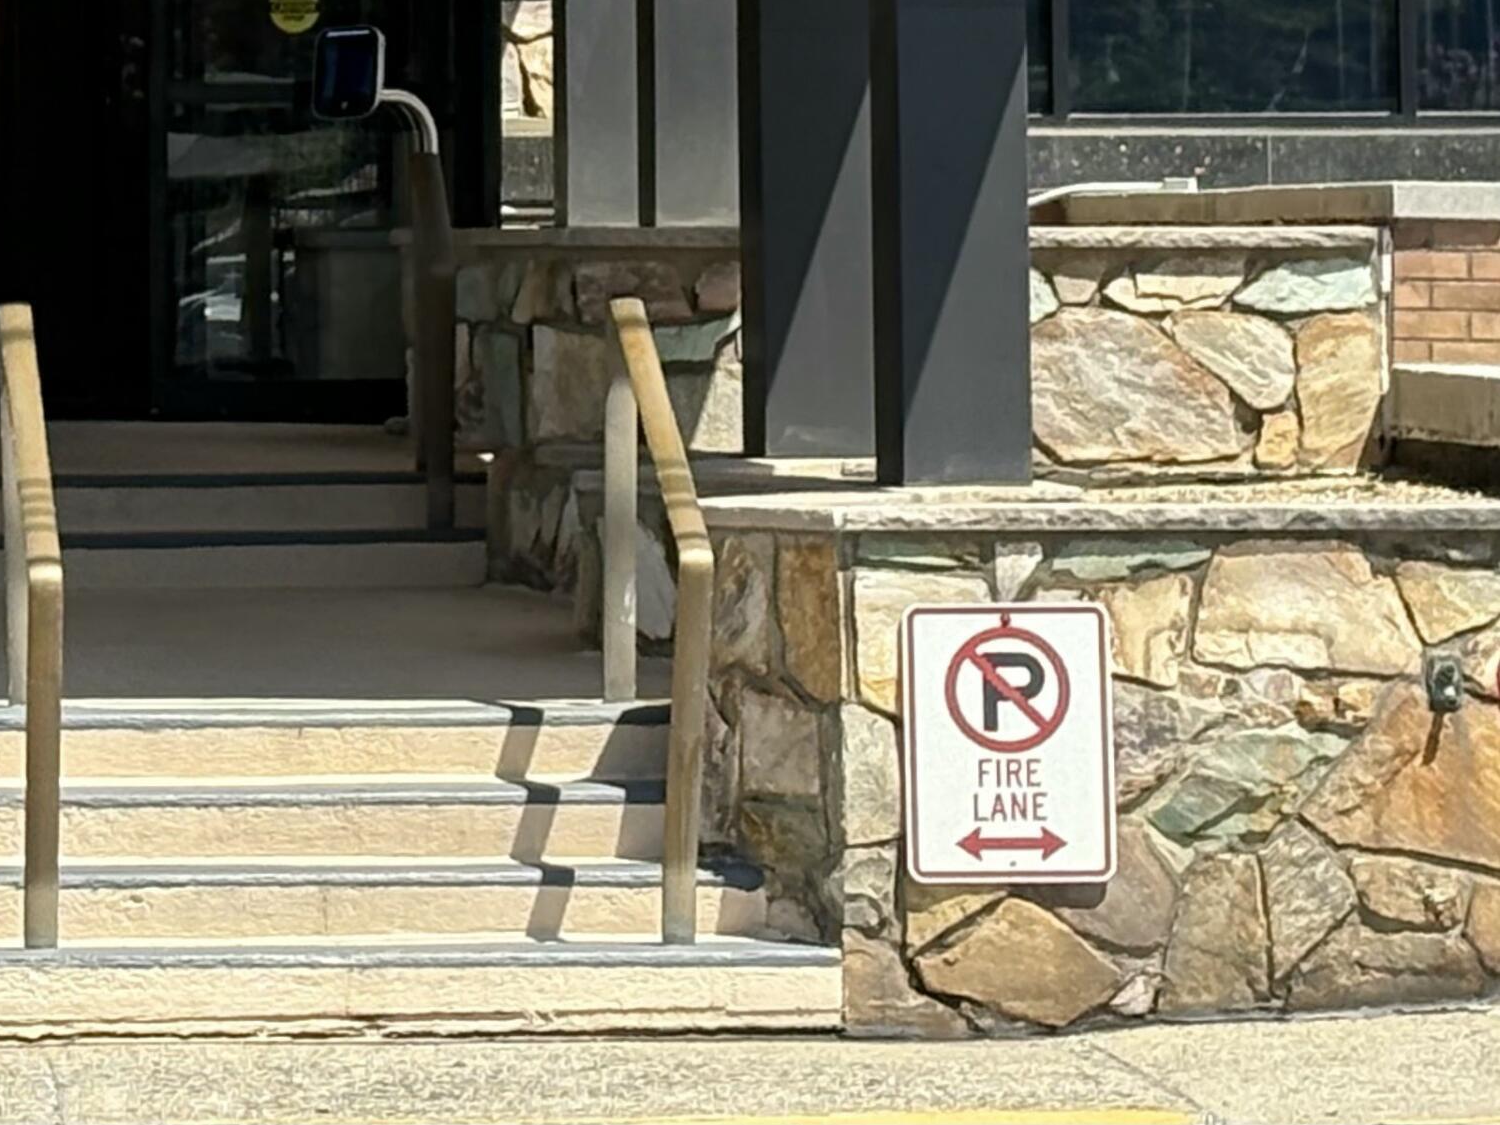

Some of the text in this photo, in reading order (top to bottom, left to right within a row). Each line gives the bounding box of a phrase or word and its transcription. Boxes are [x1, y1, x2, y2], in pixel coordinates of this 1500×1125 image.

[983, 652, 1045, 731] P
[978, 758, 1042, 788] FIRE
[973, 792, 1048, 822] LANE
